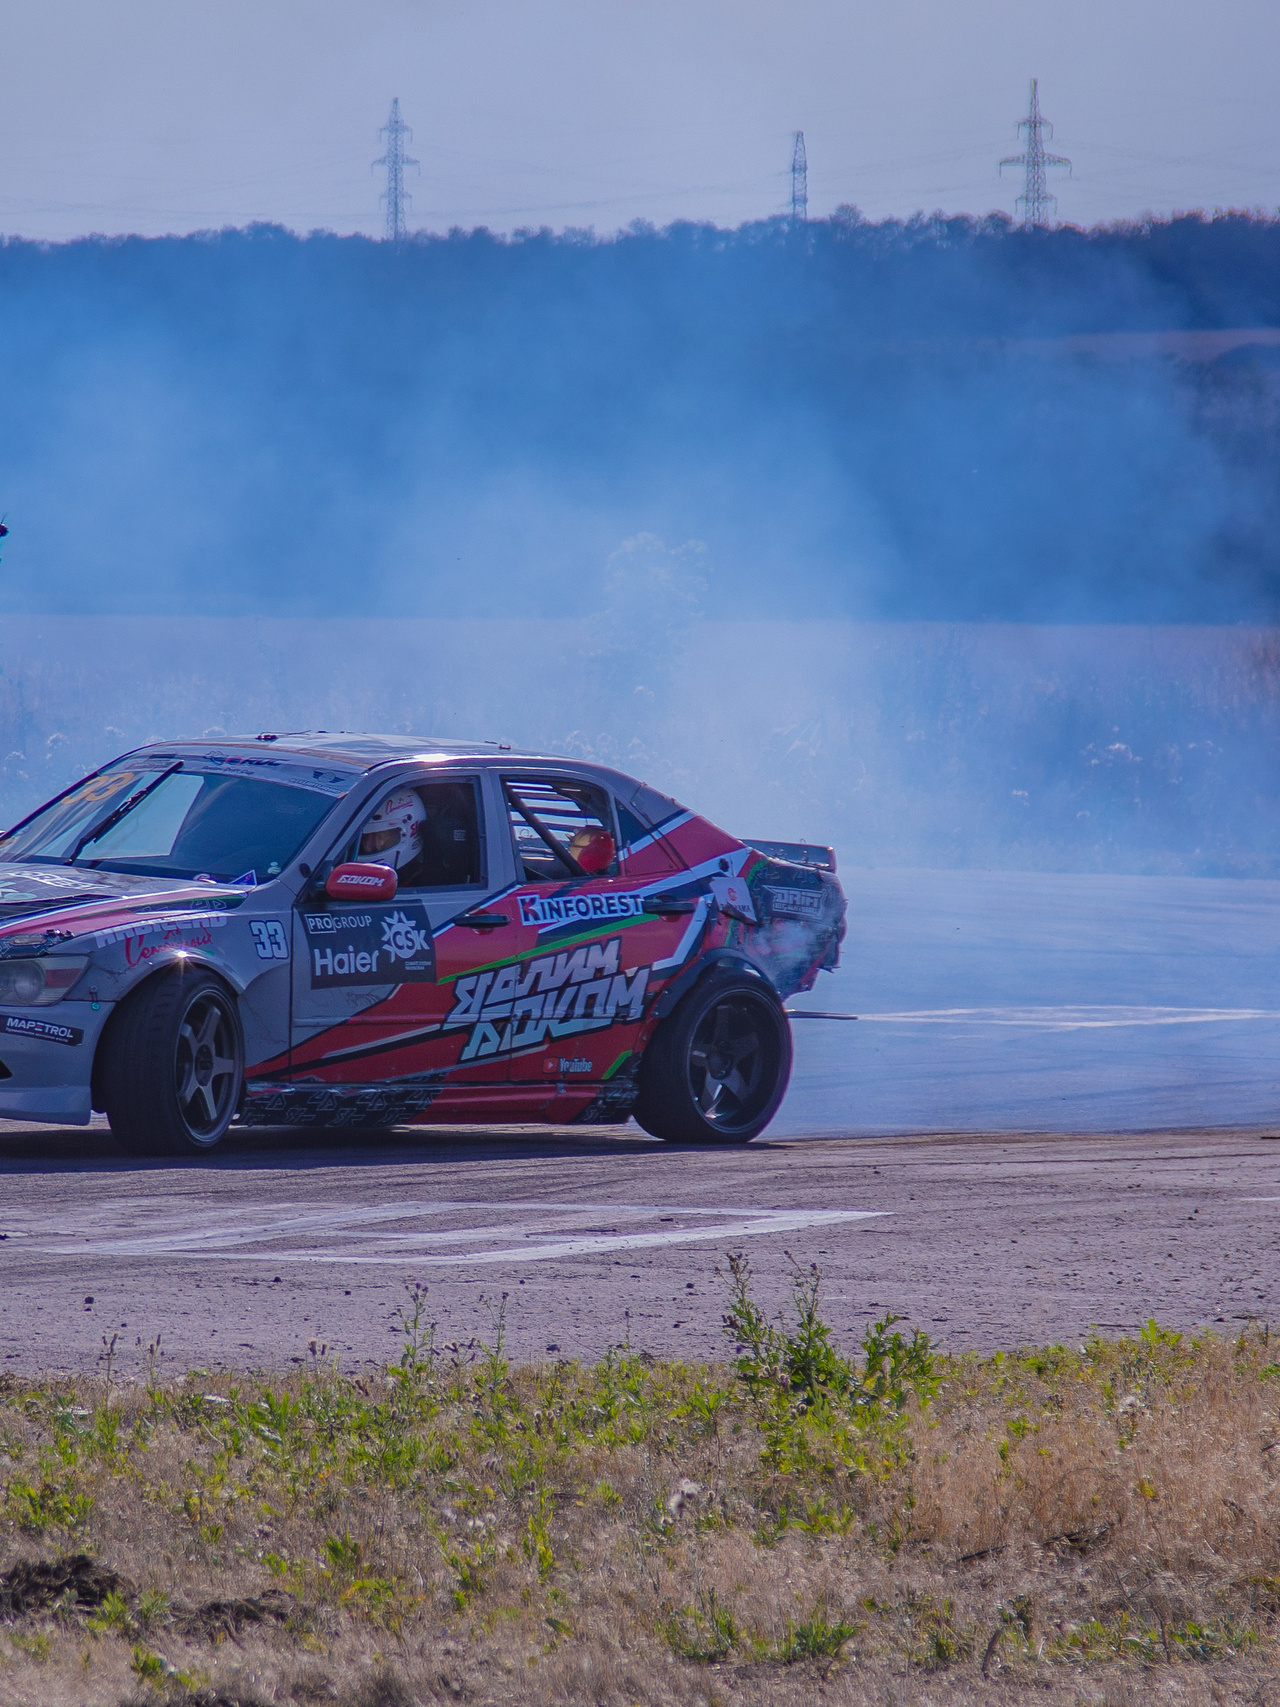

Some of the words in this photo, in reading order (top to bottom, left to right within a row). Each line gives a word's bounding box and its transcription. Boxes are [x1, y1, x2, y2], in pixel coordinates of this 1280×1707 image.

[61, 772, 134, 805] 33
[519, 893, 643, 923] KINFOREST
[249, 920, 290, 959] 33
[392, 929, 430, 952] CSK
[313, 945, 380, 976] Haier
[560, 1058, 593, 1073] YouTube
